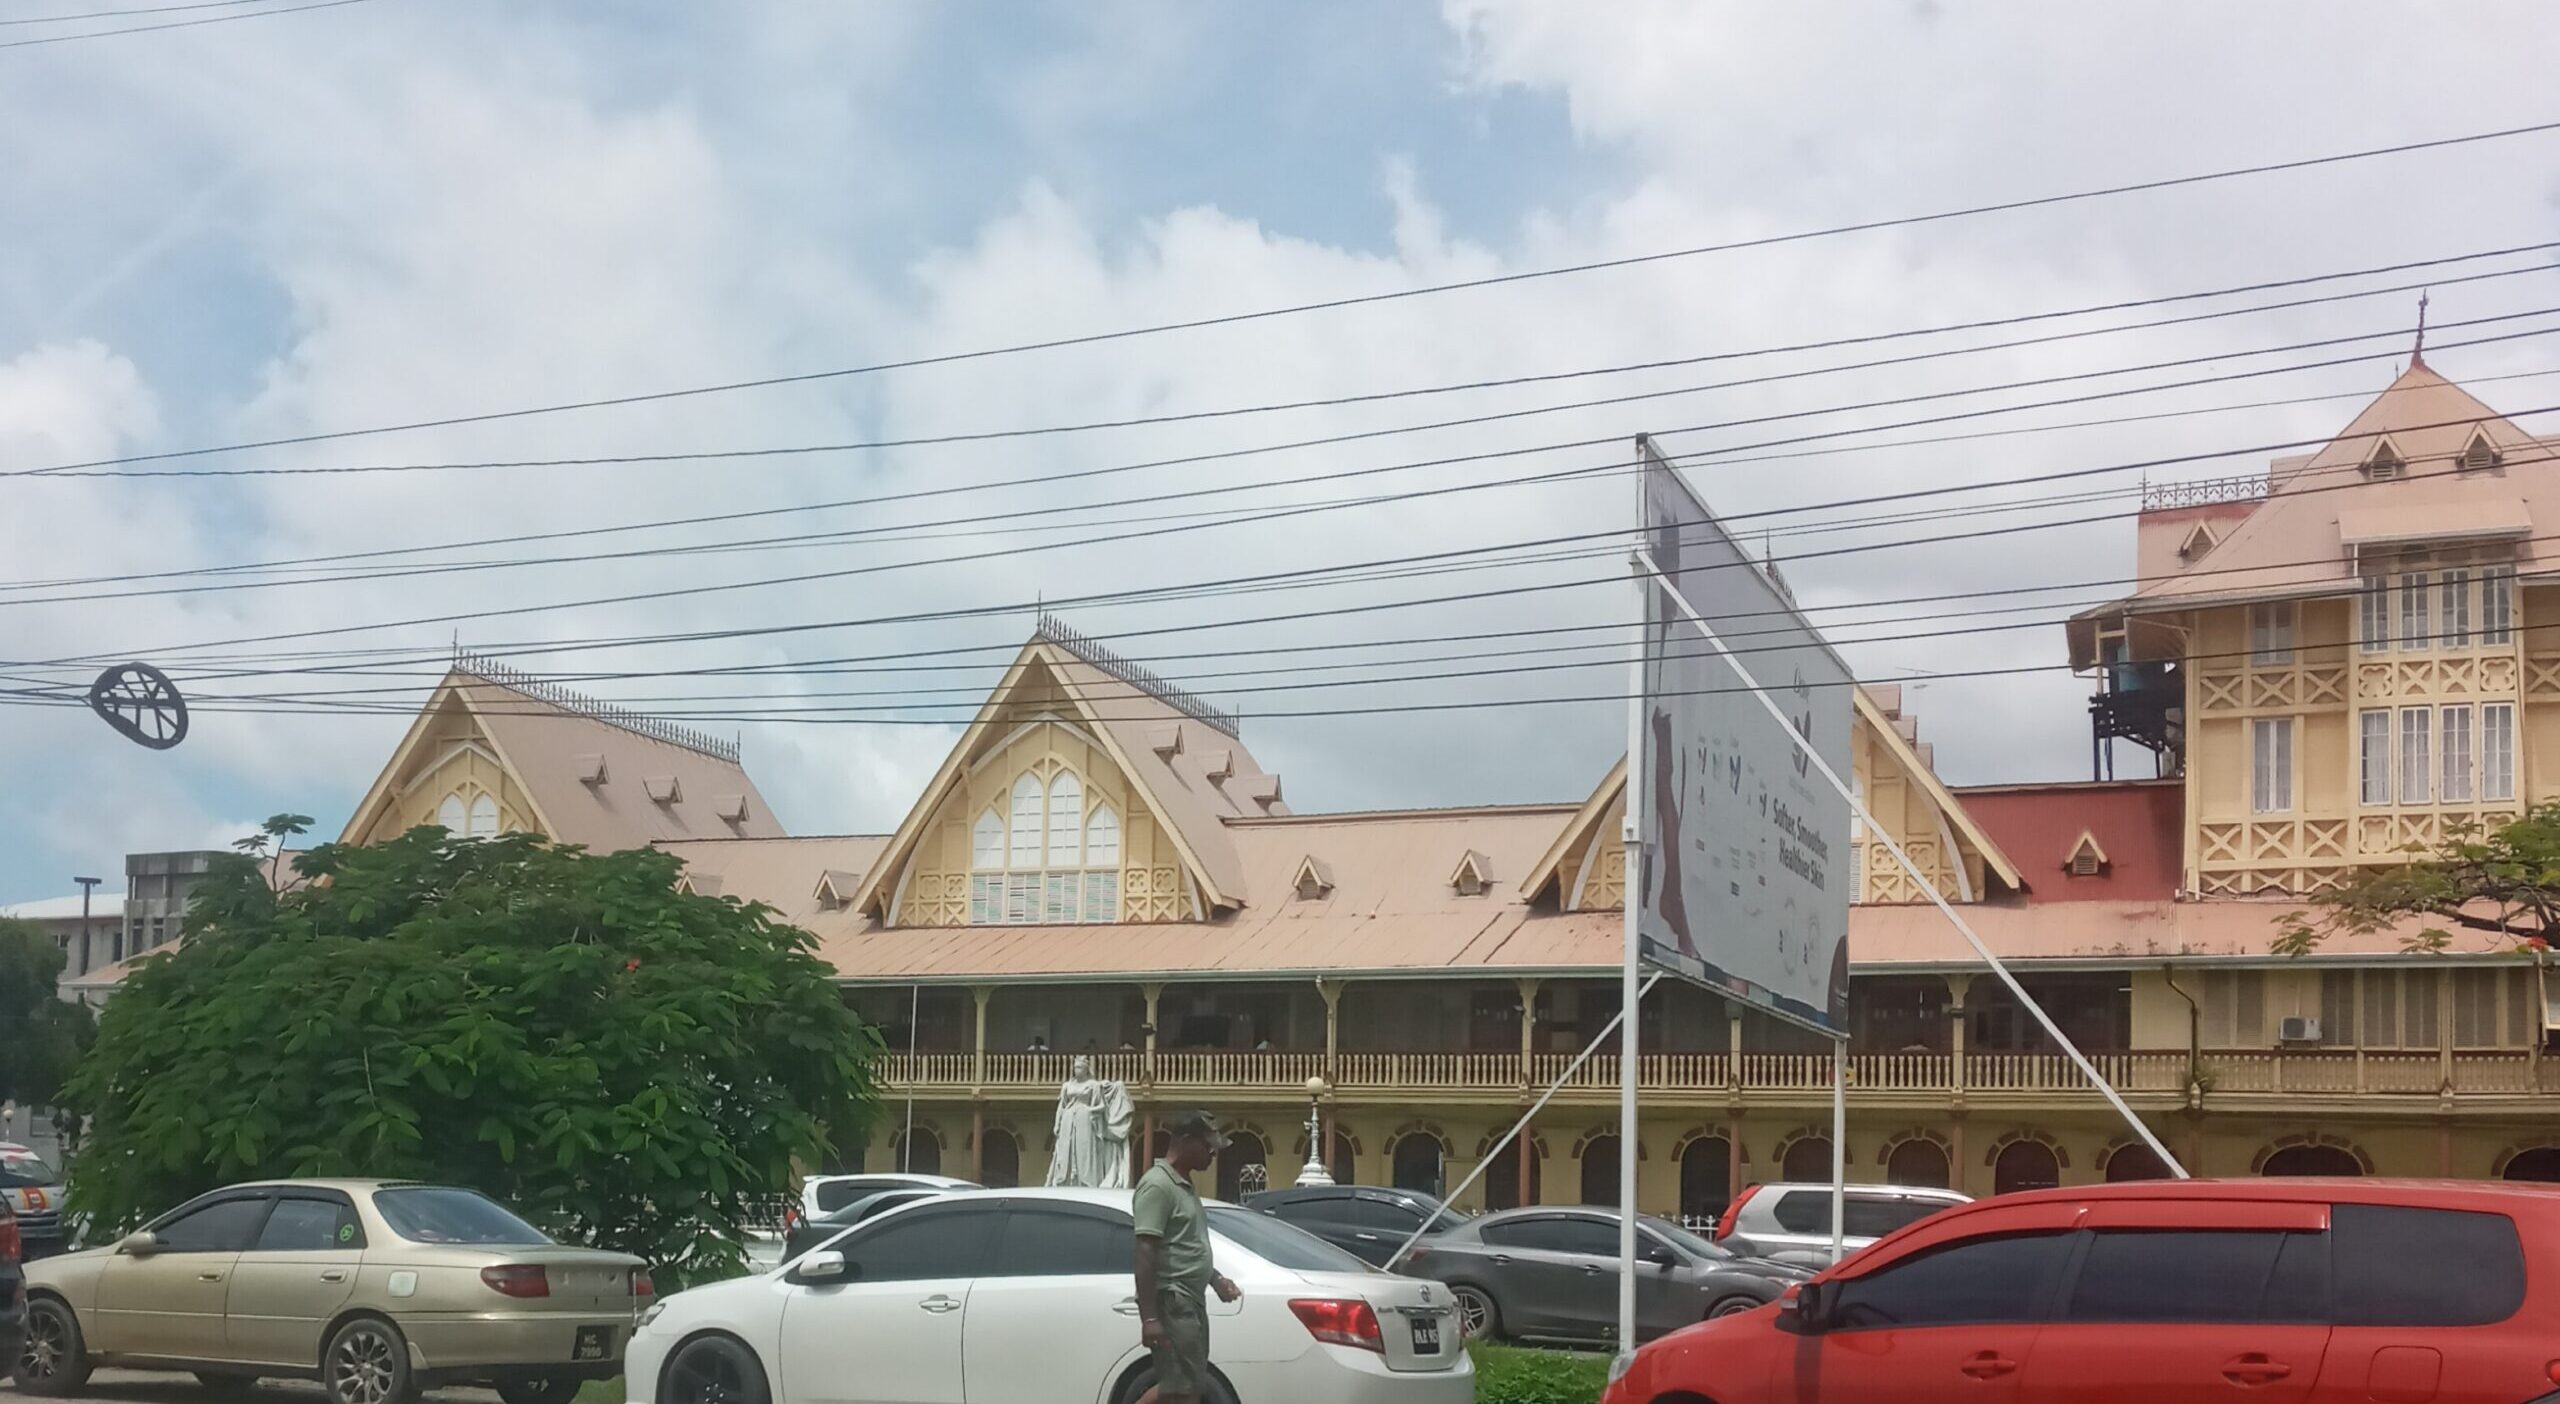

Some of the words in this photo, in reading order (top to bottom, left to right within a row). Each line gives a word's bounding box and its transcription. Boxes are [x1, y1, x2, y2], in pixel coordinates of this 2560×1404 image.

[1773, 797, 1796, 842] Softer,
[1797, 816, 1828, 865] Smoother,
[1780, 837, 1810, 881] Healthier
[1811, 859, 1825, 892] Skin
